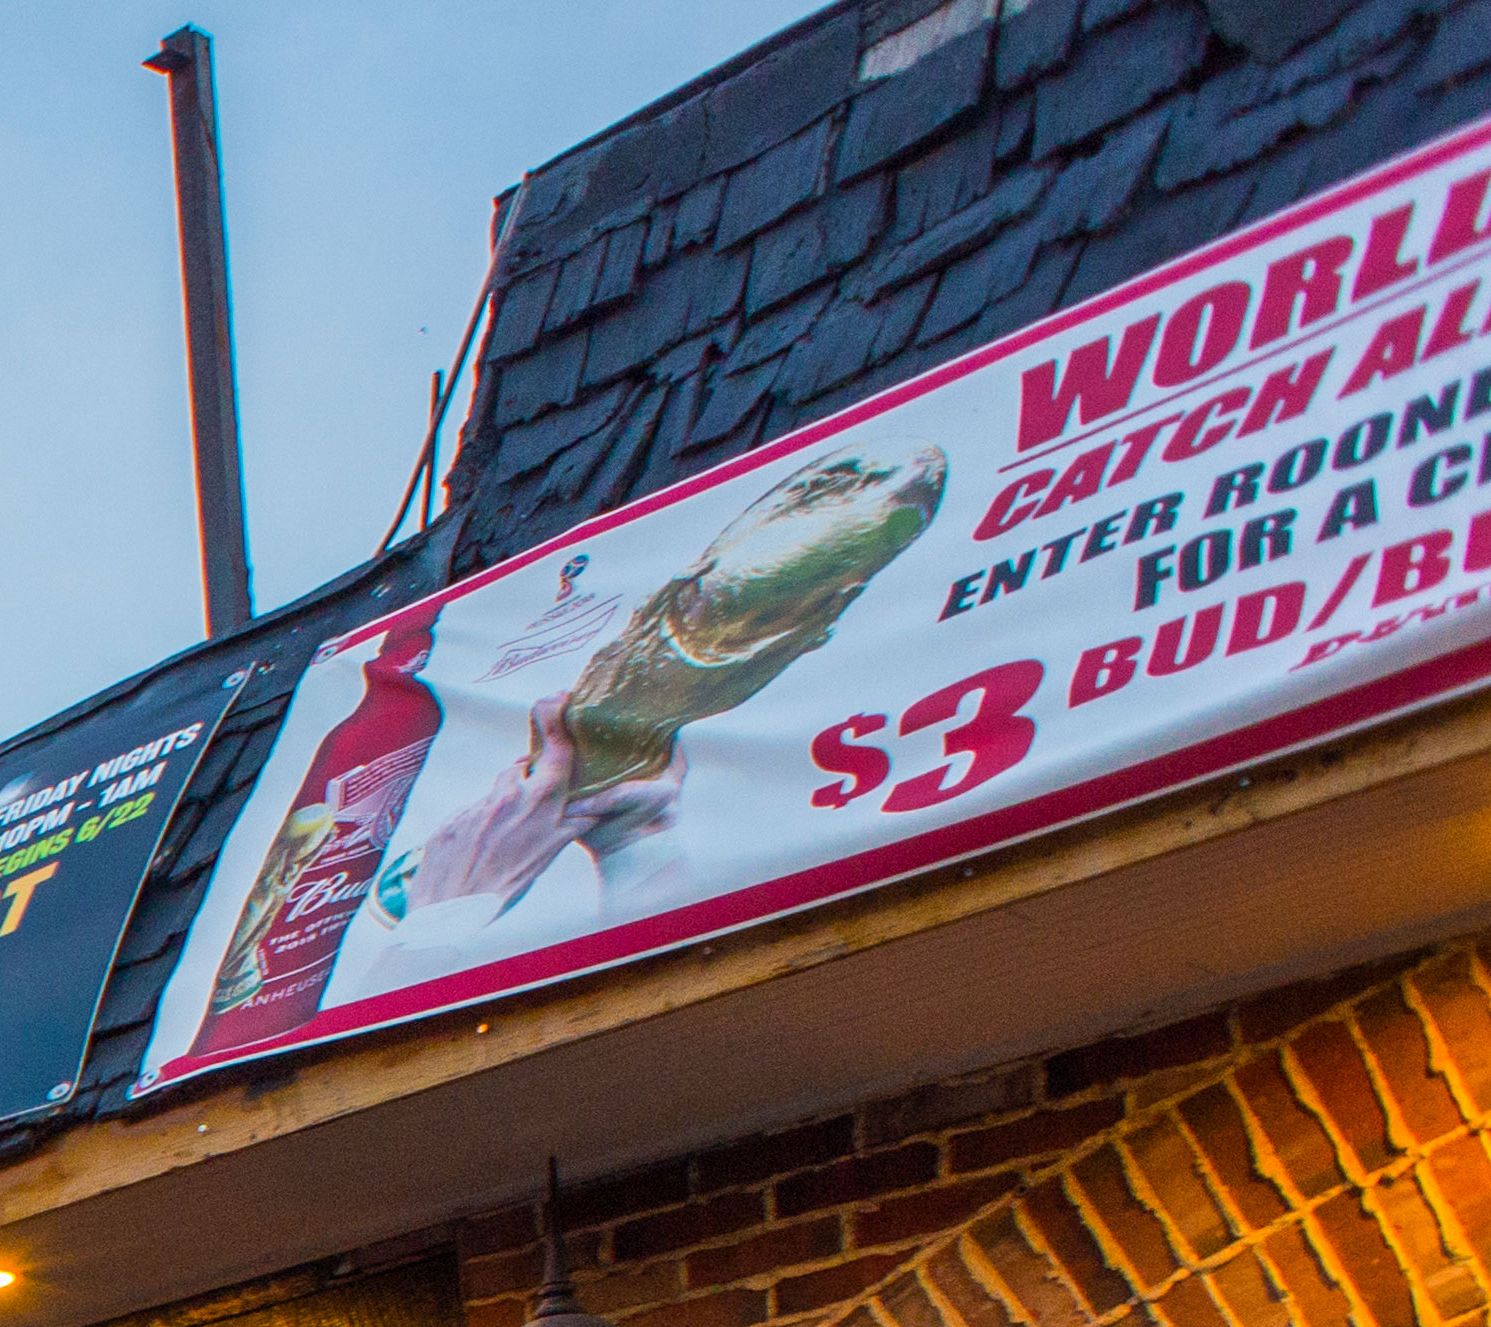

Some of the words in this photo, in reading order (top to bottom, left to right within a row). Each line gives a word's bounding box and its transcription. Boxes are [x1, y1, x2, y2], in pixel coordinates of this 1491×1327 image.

[972, 348, 1337, 542] CATCH
[1334, 273, 1491, 401] AL
[938, 492, 1185, 623] ENTER
[1134, 506, 1300, 613] FOR
[1315, 477, 1380, 544] A
[86, 721, 205, 788] NIGHTS
[98, 761, 168, 808] 1AM
[808, 657, 1046, 814] $3
[75, 792, 155, 843] 6/22
